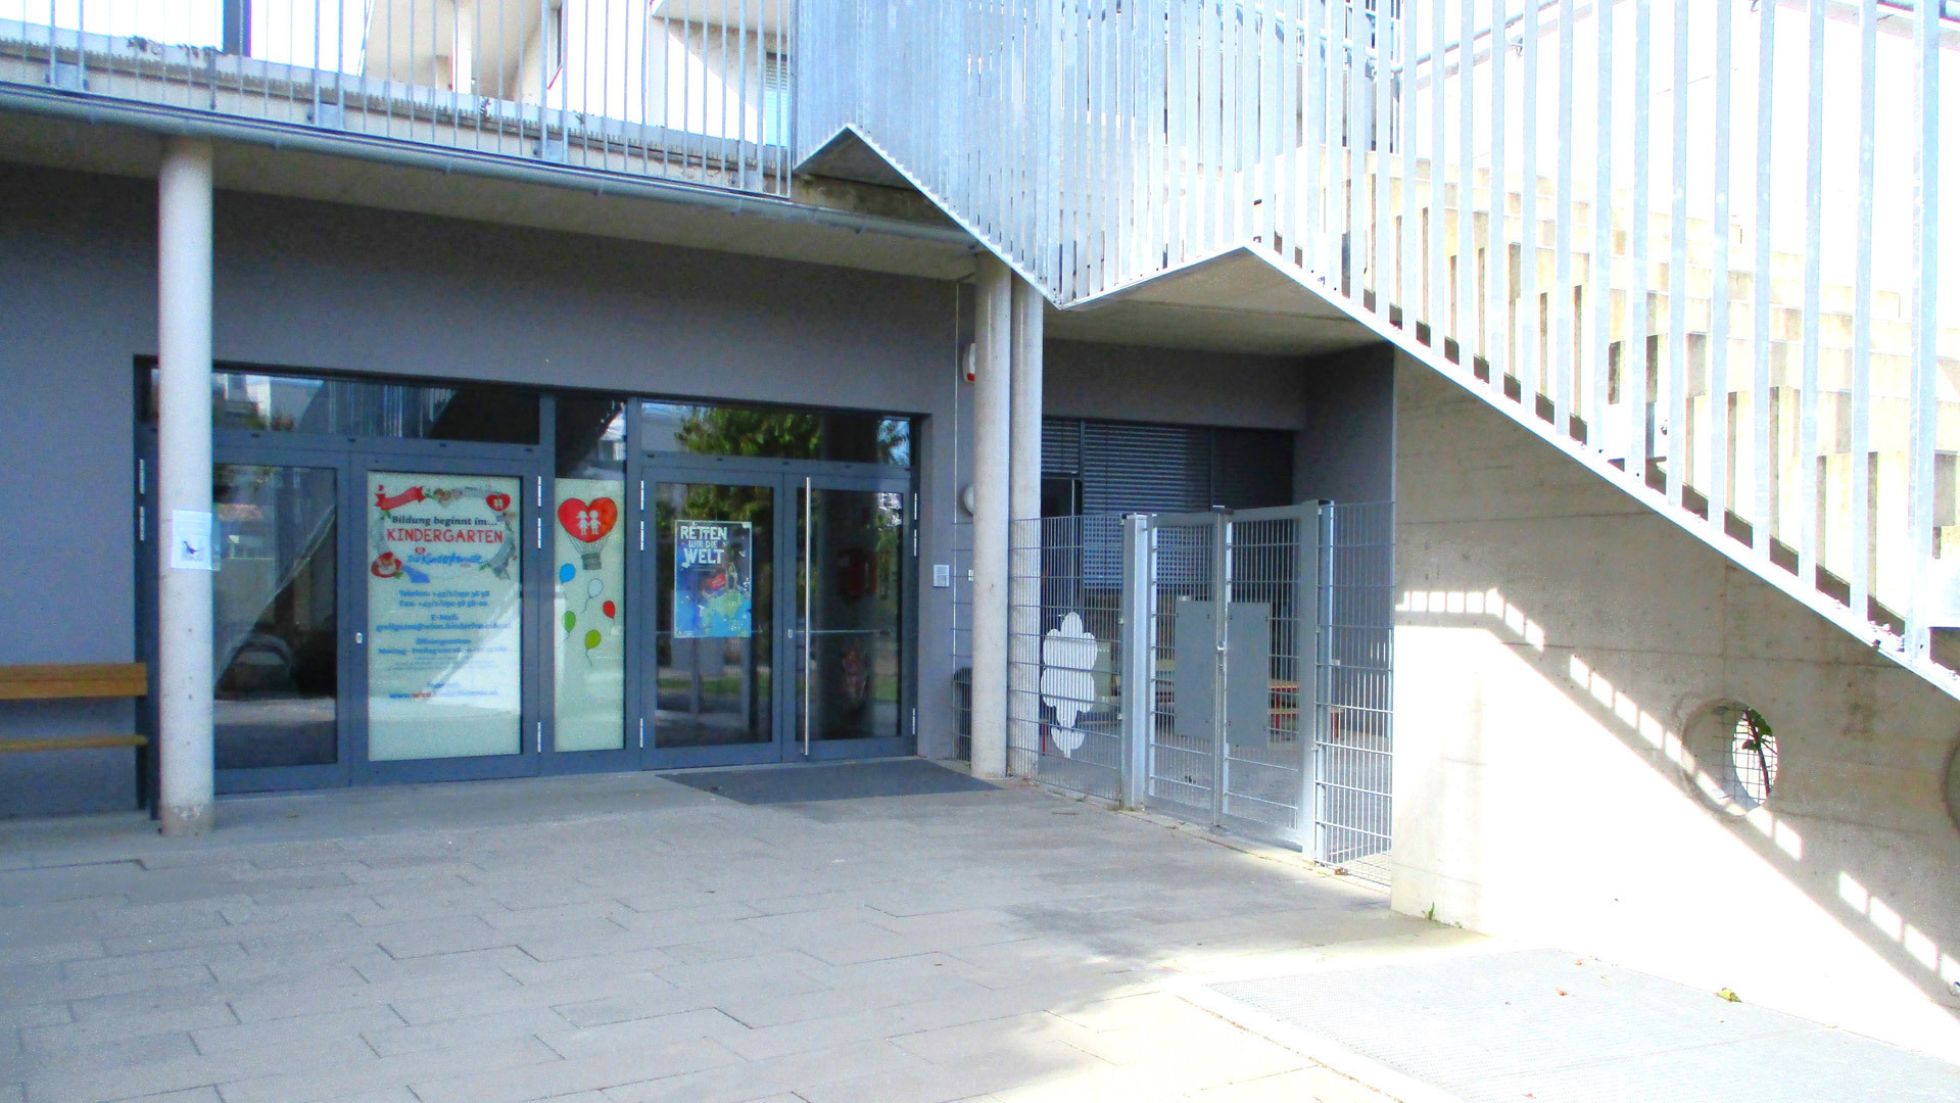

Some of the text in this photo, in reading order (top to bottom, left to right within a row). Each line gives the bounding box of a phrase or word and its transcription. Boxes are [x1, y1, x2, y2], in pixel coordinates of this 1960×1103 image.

[392, 515, 431, 527] Bildung
[433, 516, 472, 527] beginnt
[386, 528, 504, 544] KINDERGARTEN
[680, 525, 727, 541] RETTEN
[683, 548, 725, 564] WELT
